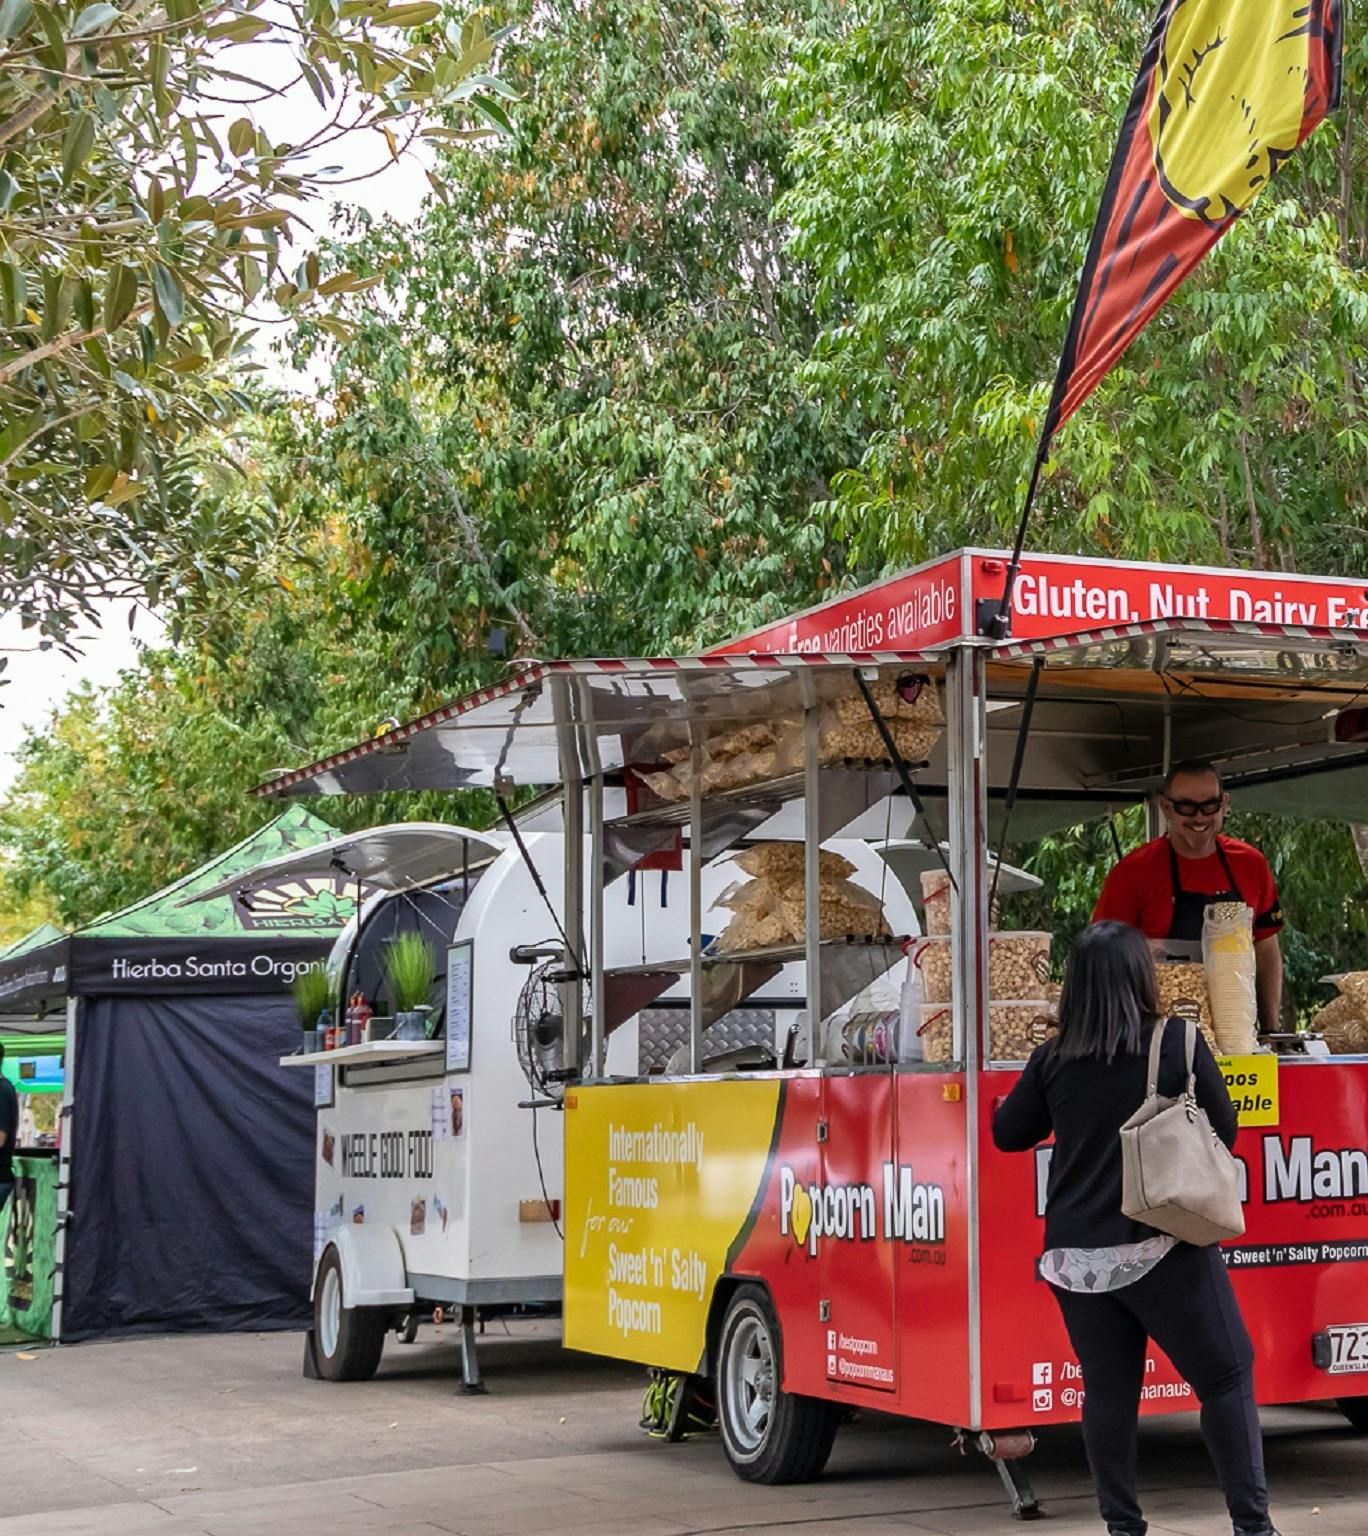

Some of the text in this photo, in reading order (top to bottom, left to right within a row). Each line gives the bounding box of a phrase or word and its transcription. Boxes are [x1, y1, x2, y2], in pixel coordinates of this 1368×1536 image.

[824, 608, 883, 652] varieties
[888, 578, 955, 641] available
[1014, 574, 1139, 622] Gluten,
[1230, 589, 1317, 626] Dairy
[112, 955, 330, 983] Hierba Santa Organi
[608, 1122, 704, 1172] Internationally
[608, 1167, 658, 1209] Famous
[883, 1163, 944, 1241] Man
[580, 1197, 605, 1259] for
[608, 1217, 634, 1233] our
[608, 1242, 647, 1286] Sweet
[671, 1247, 706, 1301] Salty
[1233, 1249, 1271, 1264] Sweet
[1288, 1246, 1318, 1262] Salty
[608, 1287, 661, 1337] Popcorn
